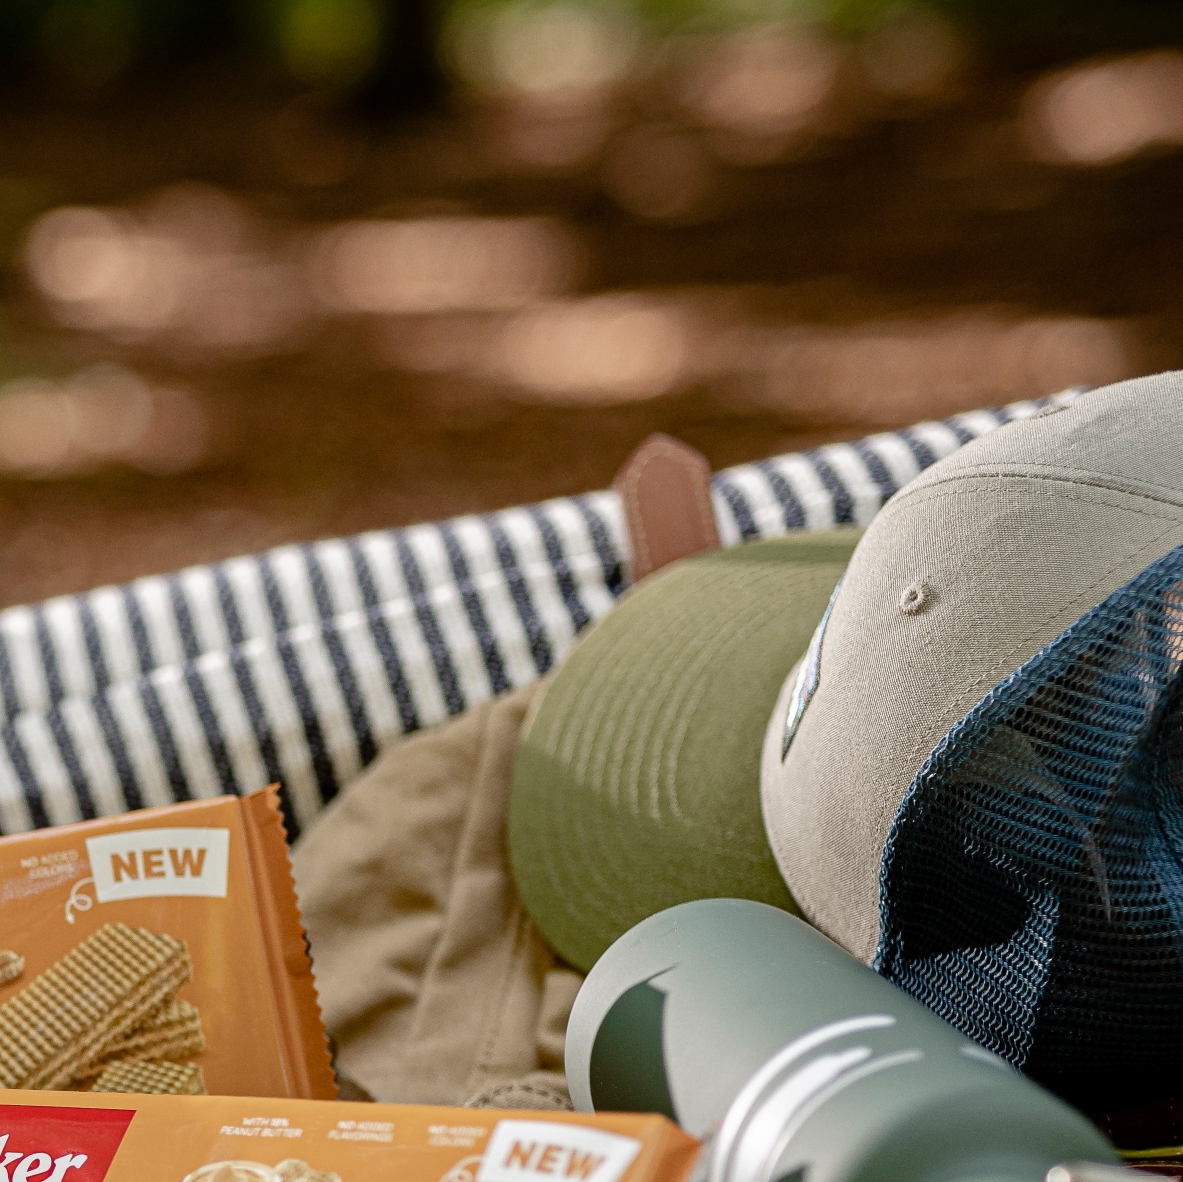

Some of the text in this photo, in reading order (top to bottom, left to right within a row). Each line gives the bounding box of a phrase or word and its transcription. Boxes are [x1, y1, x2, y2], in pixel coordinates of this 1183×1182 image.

[109, 847, 208, 883] NEW
[219, 1125, 303, 1138] PEANUT BUTTER
[503, 1139, 608, 1182] NEW
